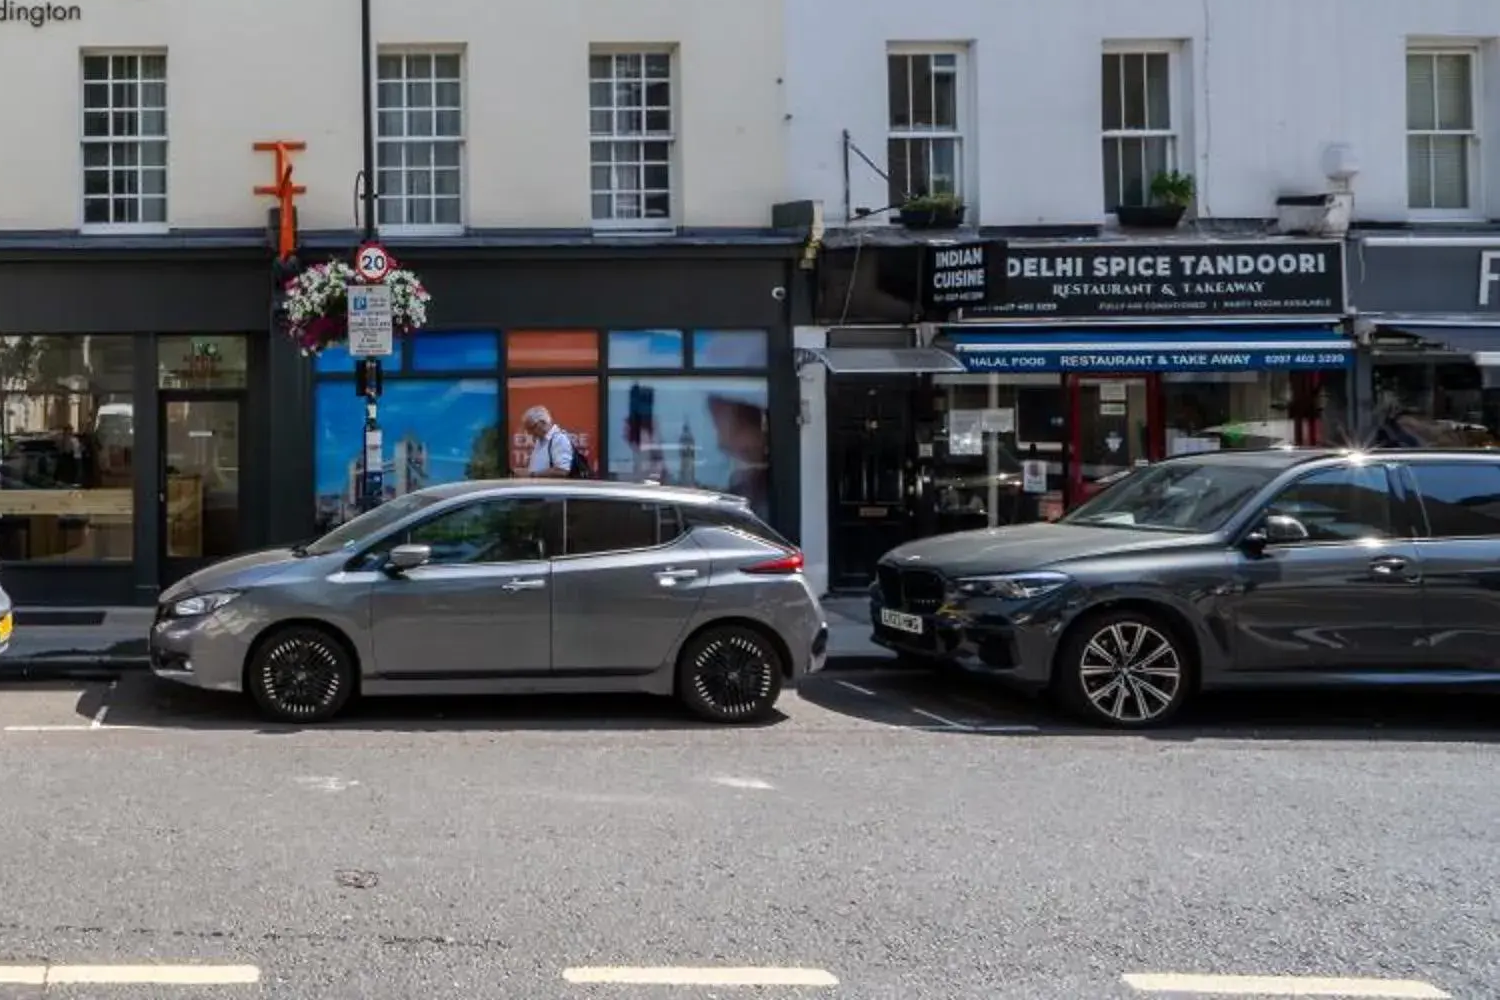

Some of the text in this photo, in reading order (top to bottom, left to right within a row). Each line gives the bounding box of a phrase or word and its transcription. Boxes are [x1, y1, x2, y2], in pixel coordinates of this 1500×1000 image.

[362, 255, 384, 271] 20
[936, 248, 983, 268] INDIAN
[1007, 253, 1326, 277] DELHI SPICE TANDOORI
[934, 269, 985, 288] CUISINE
[1053, 281, 1266, 298] RESTAURANT & TAKEAWAY
[970, 356, 1007, 367] HALAL
[1011, 356, 1046, 367] FOOD
[1060, 355, 1154, 367] RESTAURANT
[1157, 355, 1169, 365] &
[1171, 354, 1208, 366] TAKE
[1210, 354, 1251, 366] AWAY
[513, 433, 590, 448] EXRE
